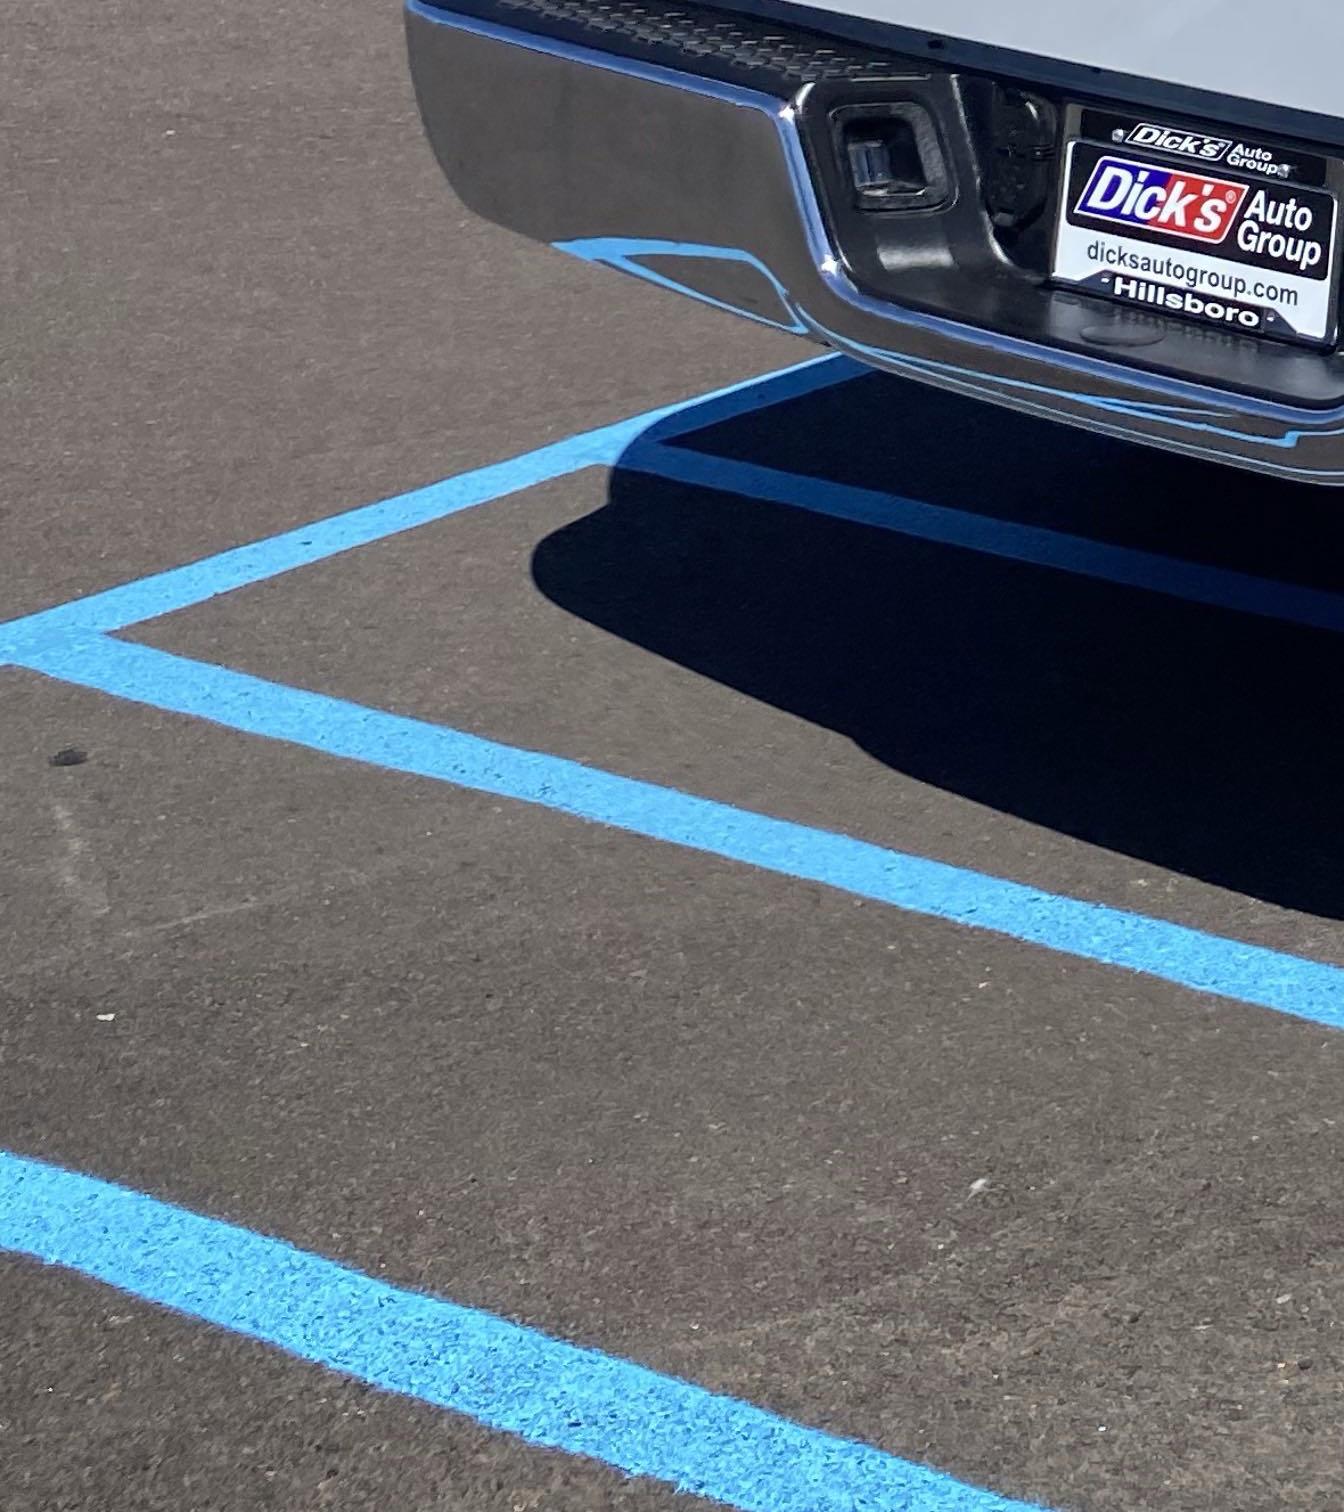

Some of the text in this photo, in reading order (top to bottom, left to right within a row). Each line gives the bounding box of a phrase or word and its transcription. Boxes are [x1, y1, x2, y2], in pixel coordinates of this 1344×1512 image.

[1133, 126, 1273, 162] Dick's Auto
[1226, 153, 1281, 176] Group
[1086, 165, 1313, 233] Dick's Auto
[1236, 219, 1322, 270] Group
[1086, 240, 1299, 307] dicksautogroup.com
[1113, 275, 1260, 327] Hillsboro
